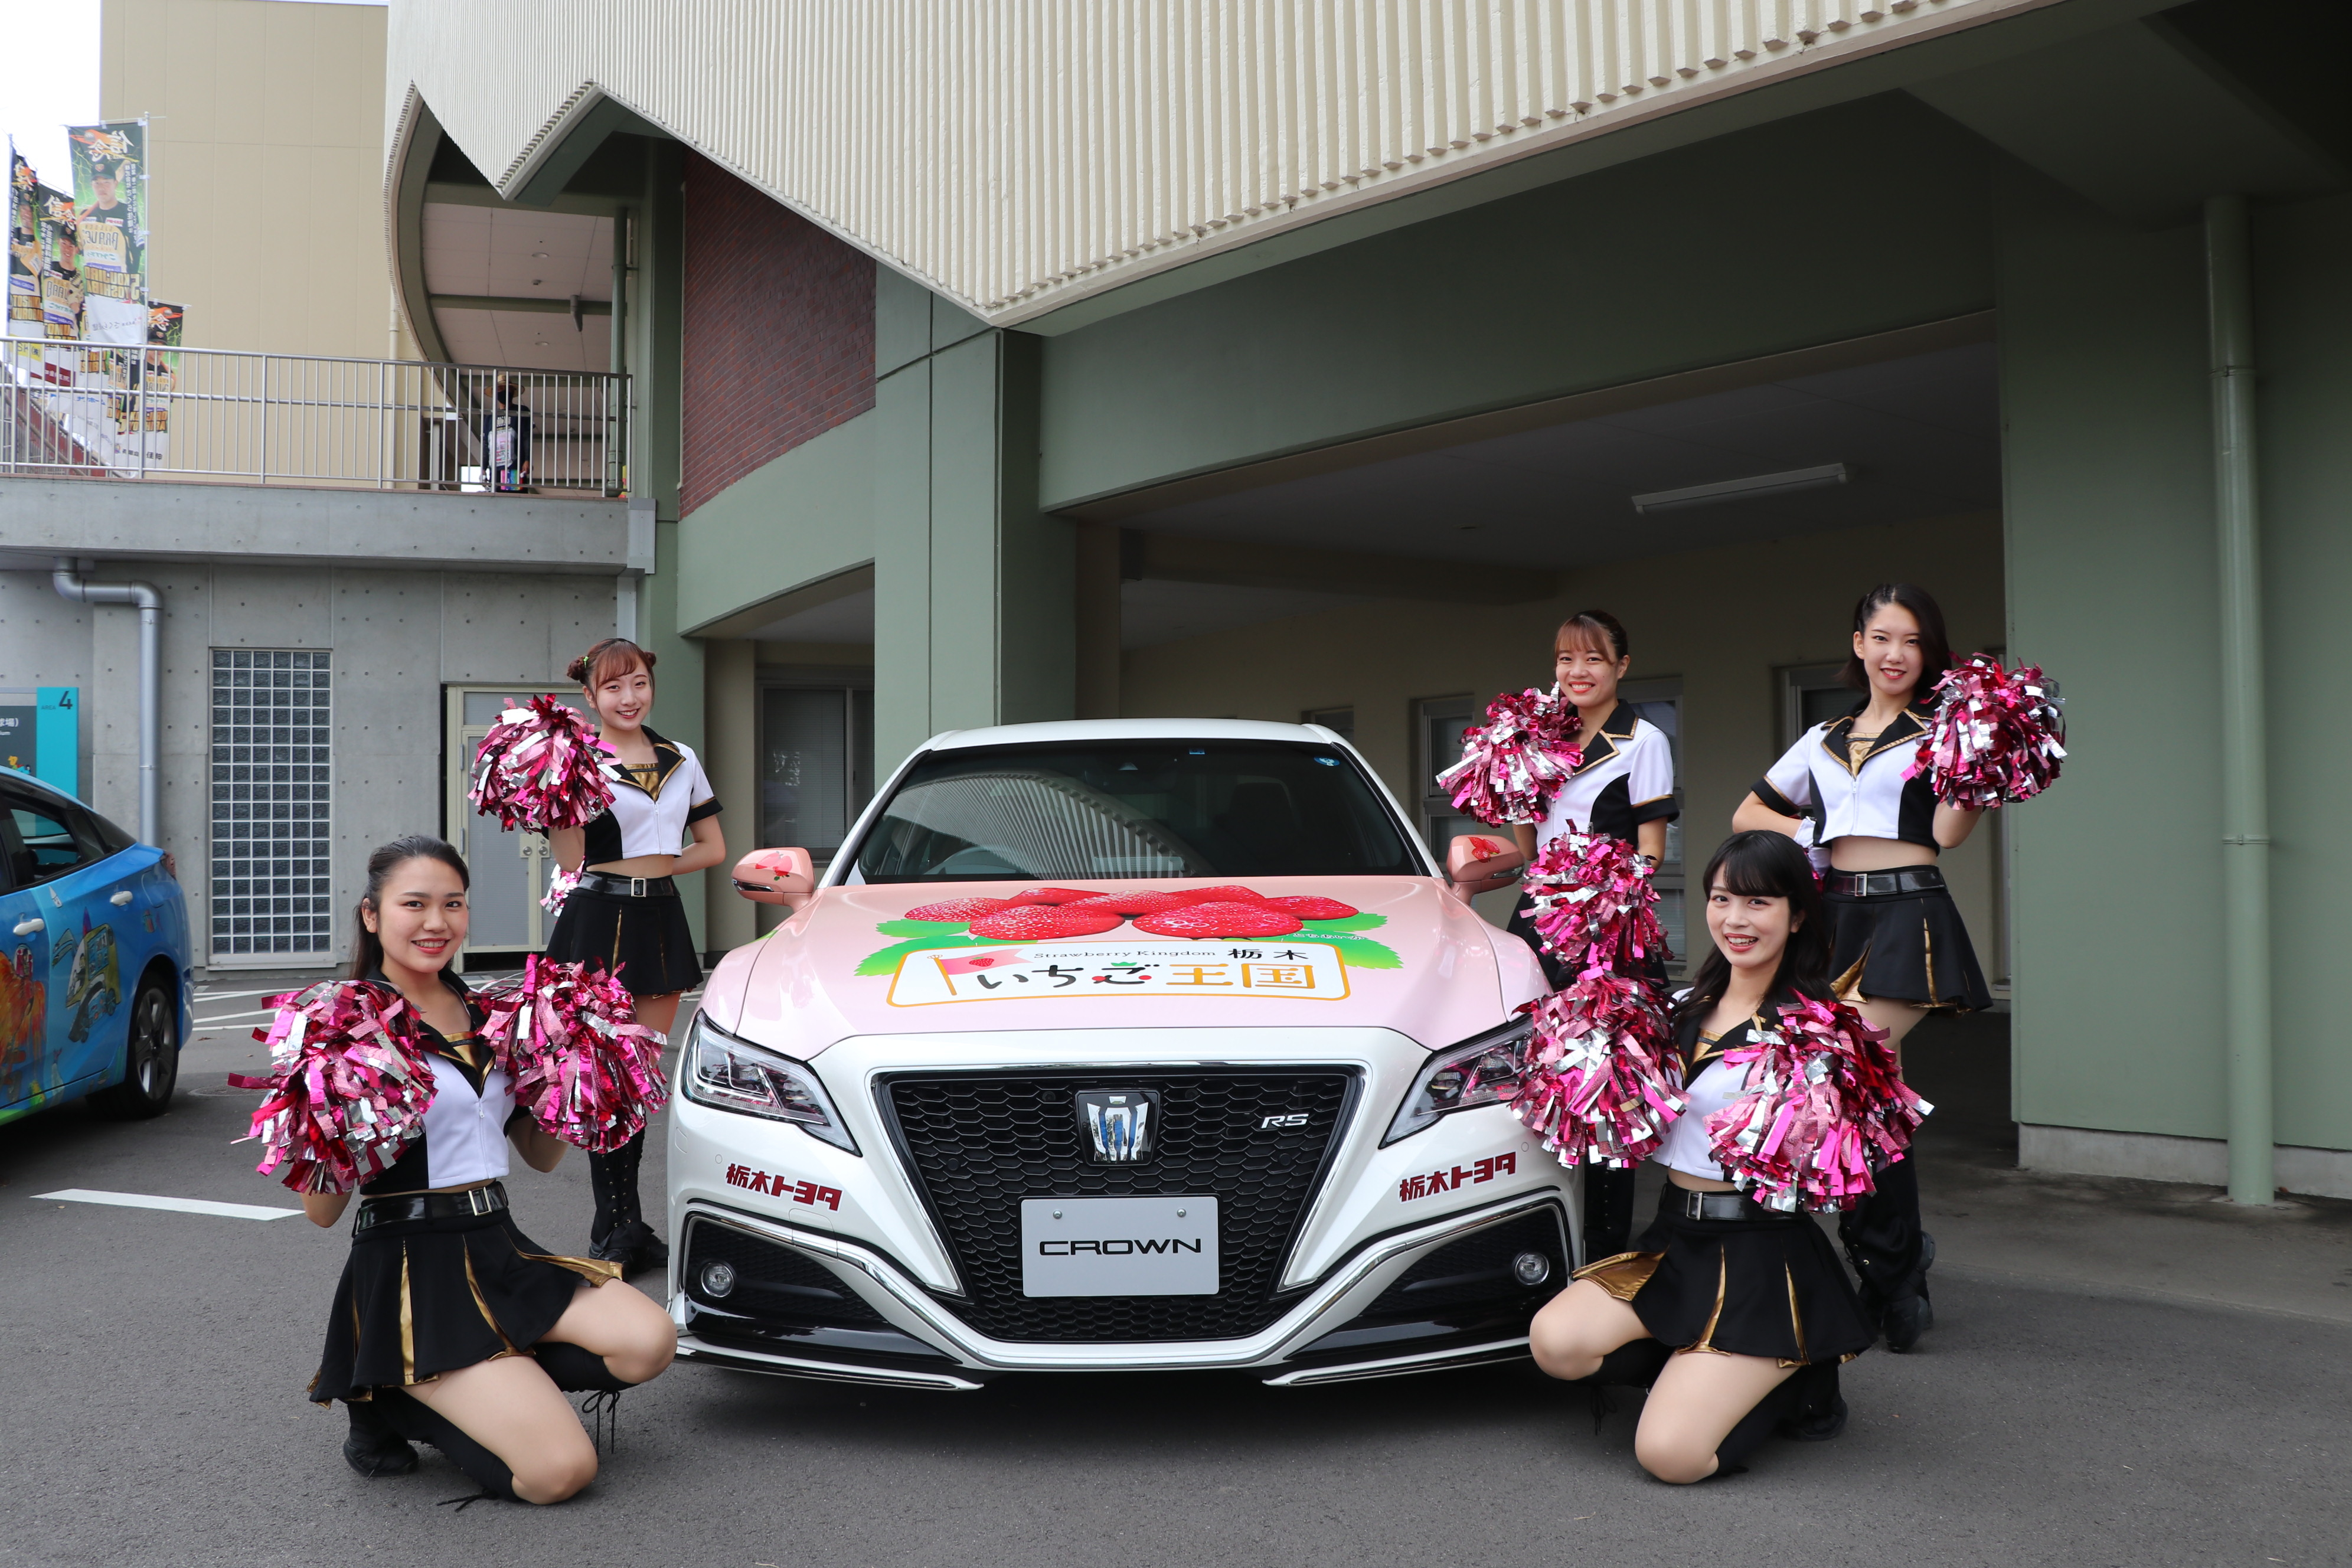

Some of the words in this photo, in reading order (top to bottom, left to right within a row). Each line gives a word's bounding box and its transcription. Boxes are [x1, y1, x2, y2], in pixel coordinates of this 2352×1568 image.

[58, 690, 73, 710] 4
[1227, 948, 1309, 961] 栃木
[976, 963, 1316, 989] いちご王国
[1260, 1113, 1309, 1129] RS
[1399, 1151, 1516, 1202] 栃木トヨタ
[726, 1163, 842, 1211] 栃木トヨタ
[1039, 1238, 1201, 1256] CROWN
